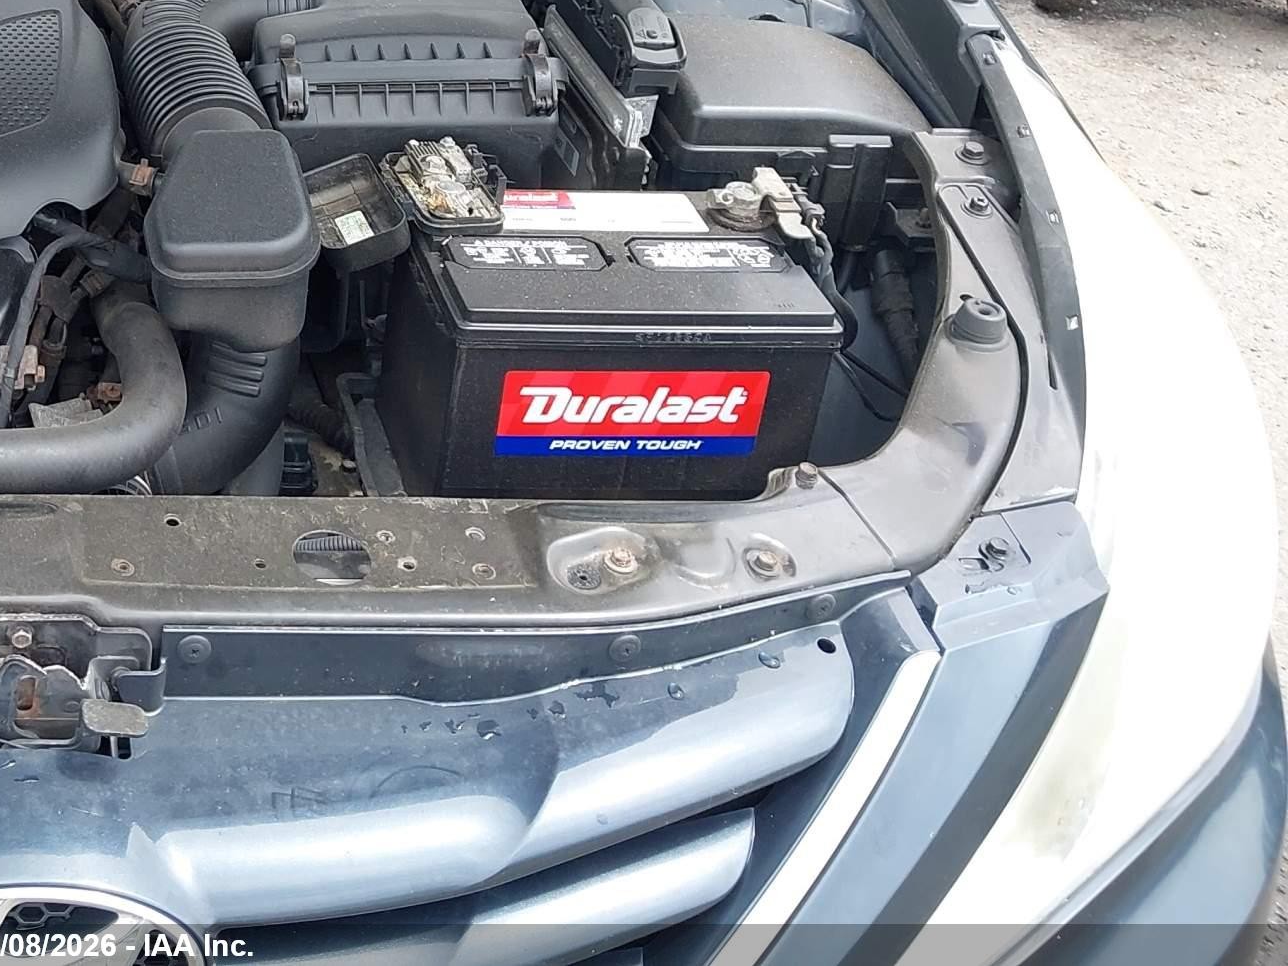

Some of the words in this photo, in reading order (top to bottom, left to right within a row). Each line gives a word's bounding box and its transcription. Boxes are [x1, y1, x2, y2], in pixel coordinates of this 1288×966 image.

[520, 387, 748, 423] Duralast
[549, 440, 629, 450] PROVEN
[636, 440, 701, 450] TOUGH
